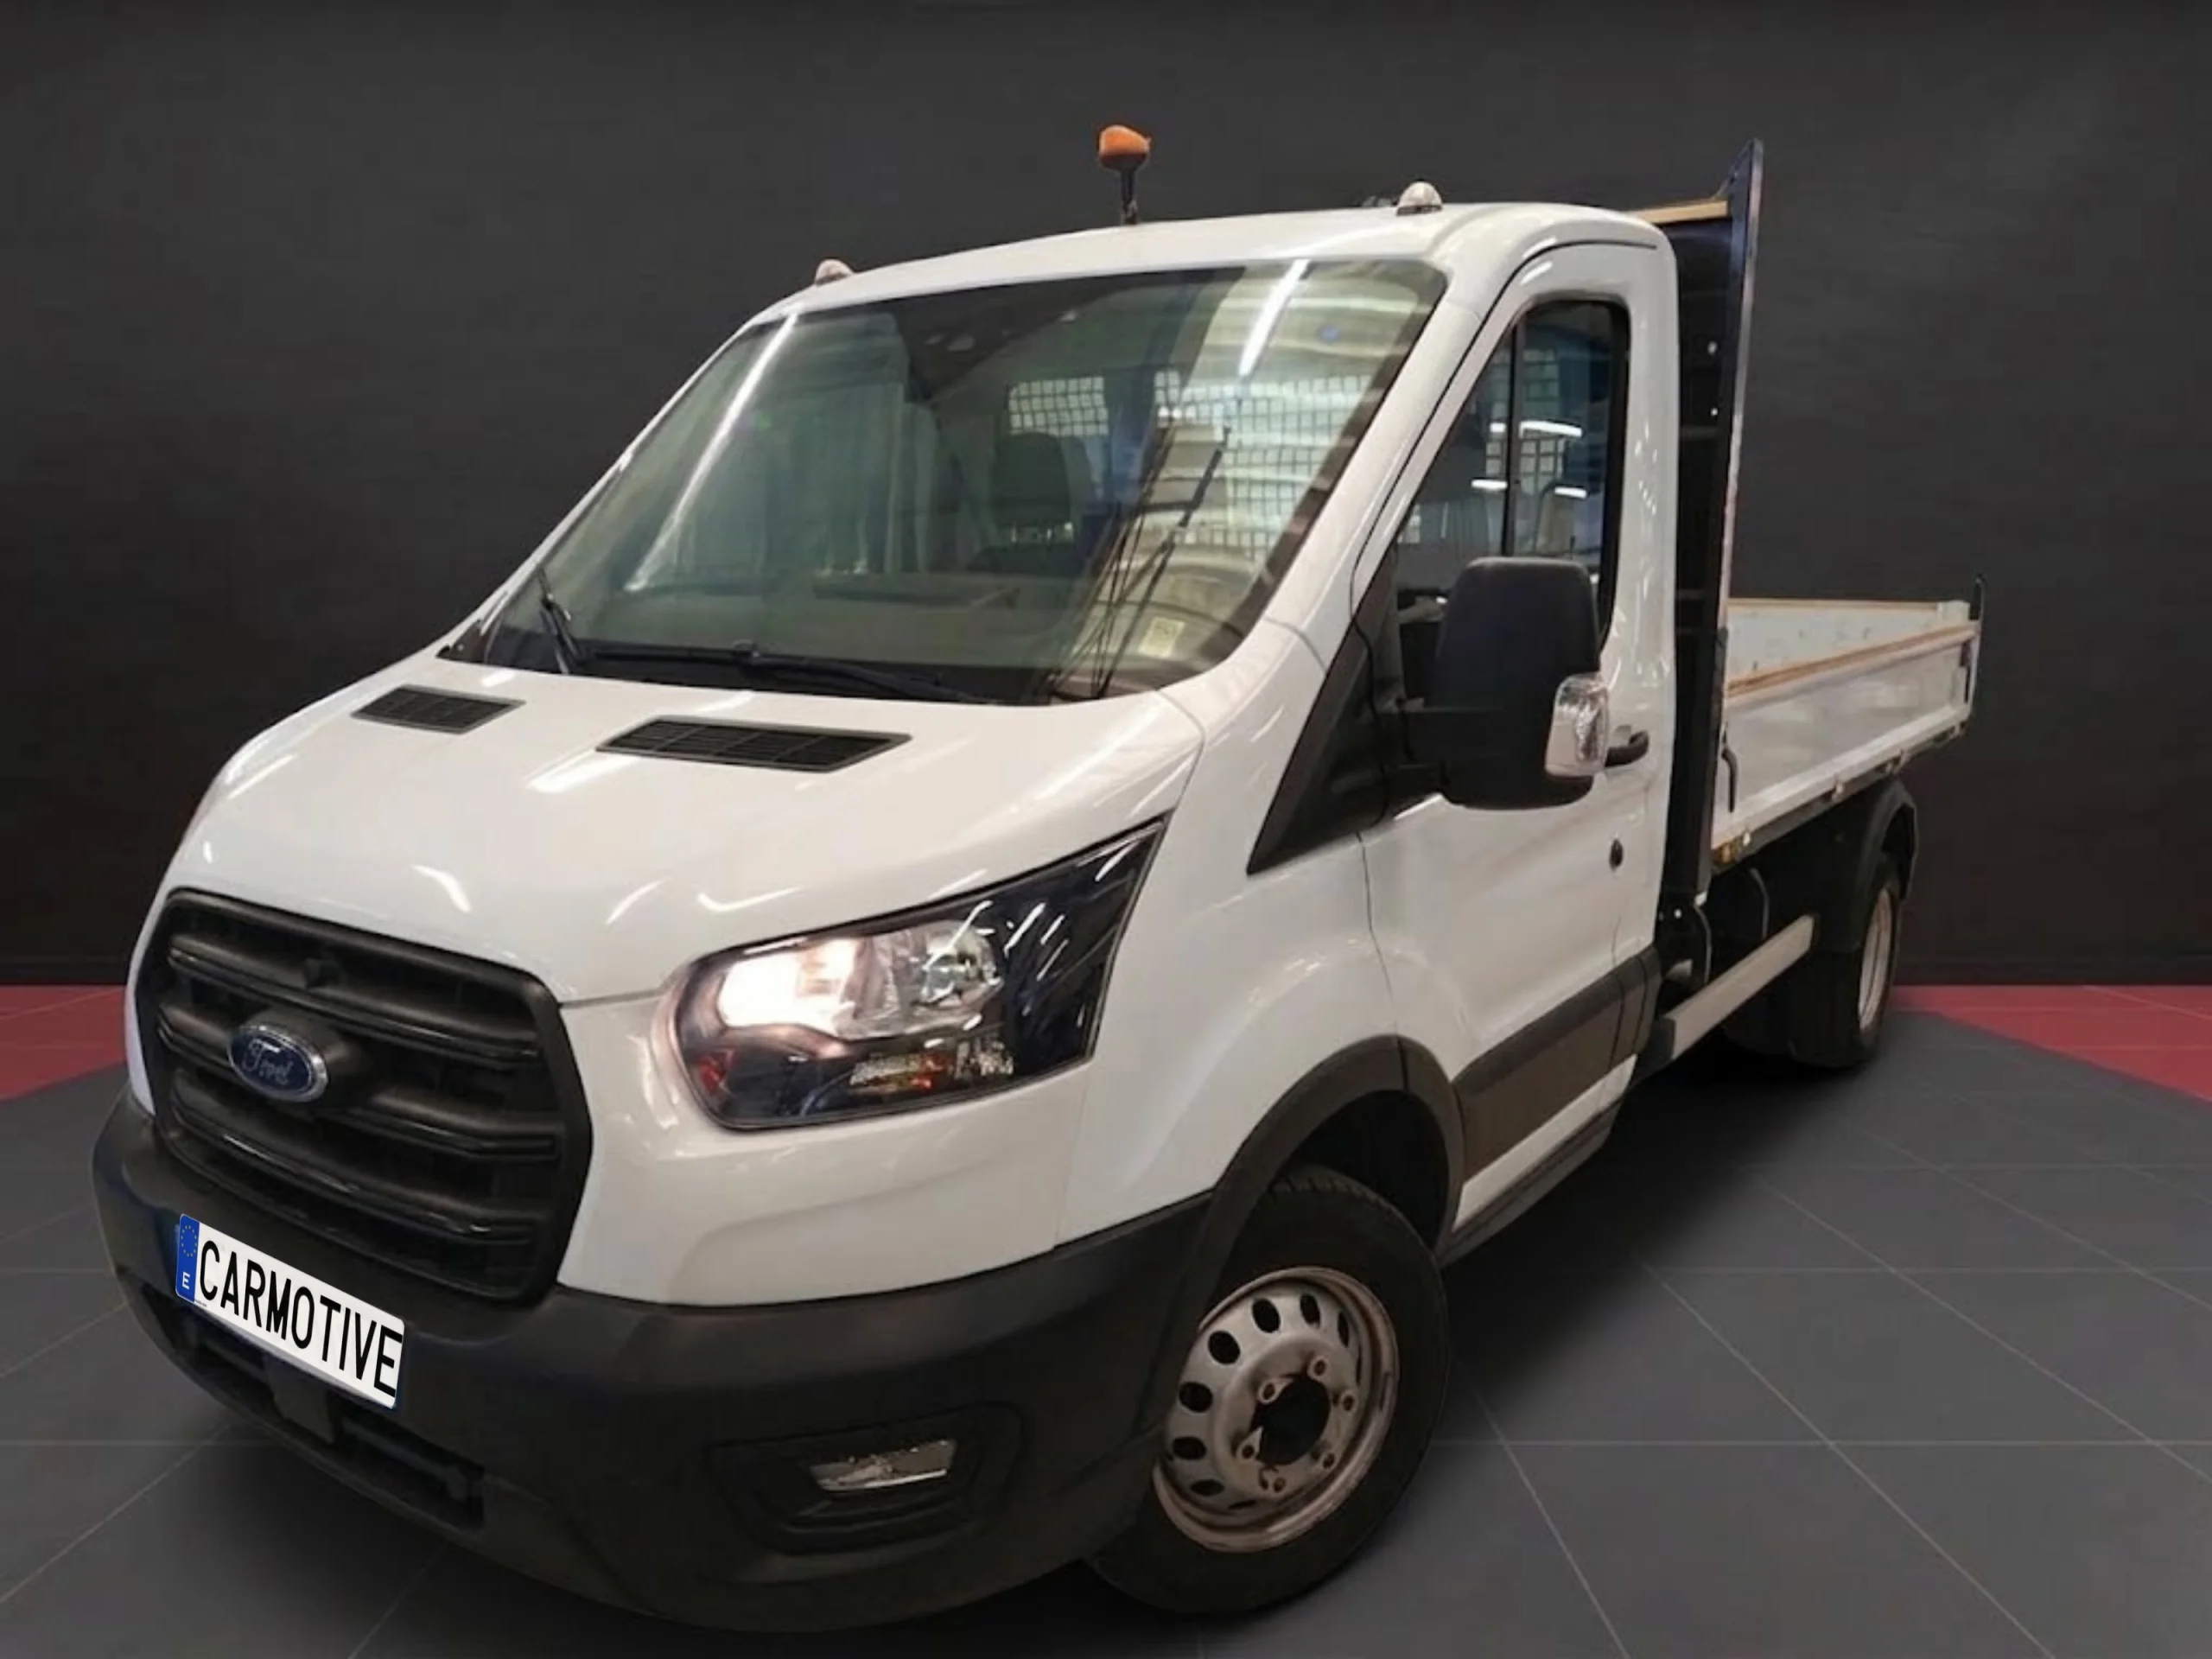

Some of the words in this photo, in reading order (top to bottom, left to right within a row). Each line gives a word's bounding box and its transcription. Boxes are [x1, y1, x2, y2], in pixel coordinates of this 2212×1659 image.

[242, 1038, 295, 1085] Ford
[181, 1271, 191, 1290] E
[200, 1240, 404, 1398] CARMOTIVE
